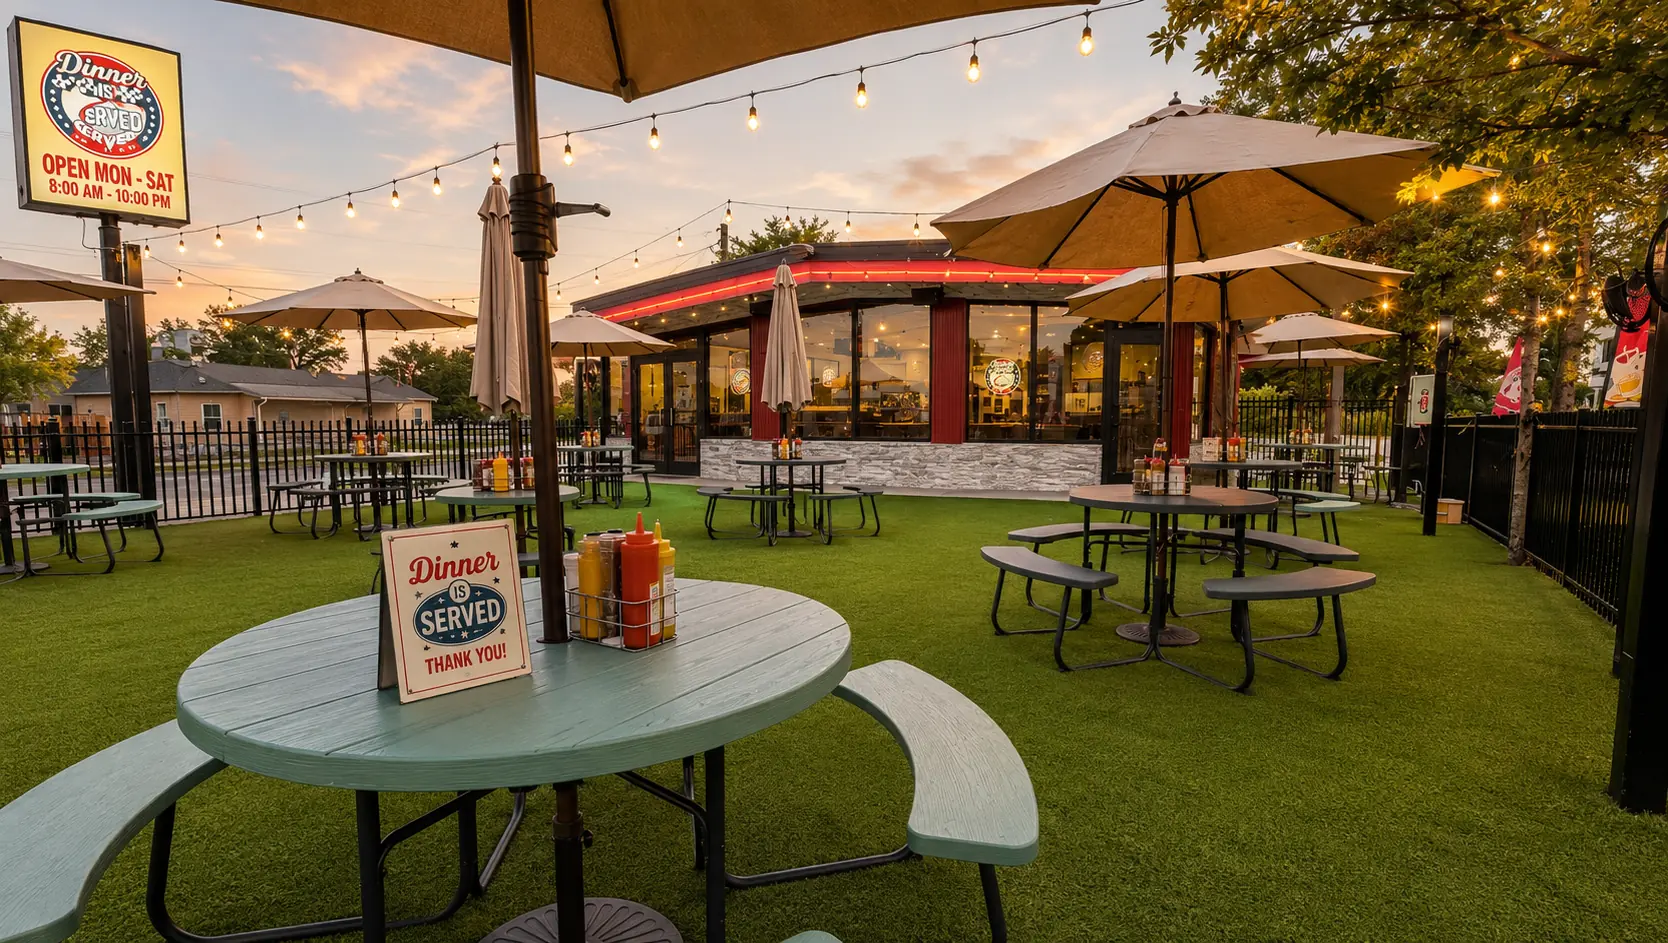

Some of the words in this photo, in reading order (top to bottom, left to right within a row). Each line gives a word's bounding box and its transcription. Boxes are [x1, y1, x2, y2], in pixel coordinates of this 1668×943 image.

[56, 50, 148, 89] Dinner
[42, 153, 90, 180] OPEN
[94, 161, 132, 187] MON
[145, 170, 175, 193] SAT
[49, 178, 79, 196] 8:00
[83, 183, 104, 200] AM
[115, 188, 149, 206] 10:00
[152, 193, 171, 209] PM
[408, 551, 500, 585] Dinner
[453, 584, 466, 599] IS
[420, 598, 501, 636] SERVED
[425, 649, 473, 675] THANK
[475, 642, 507, 664] YOU!
